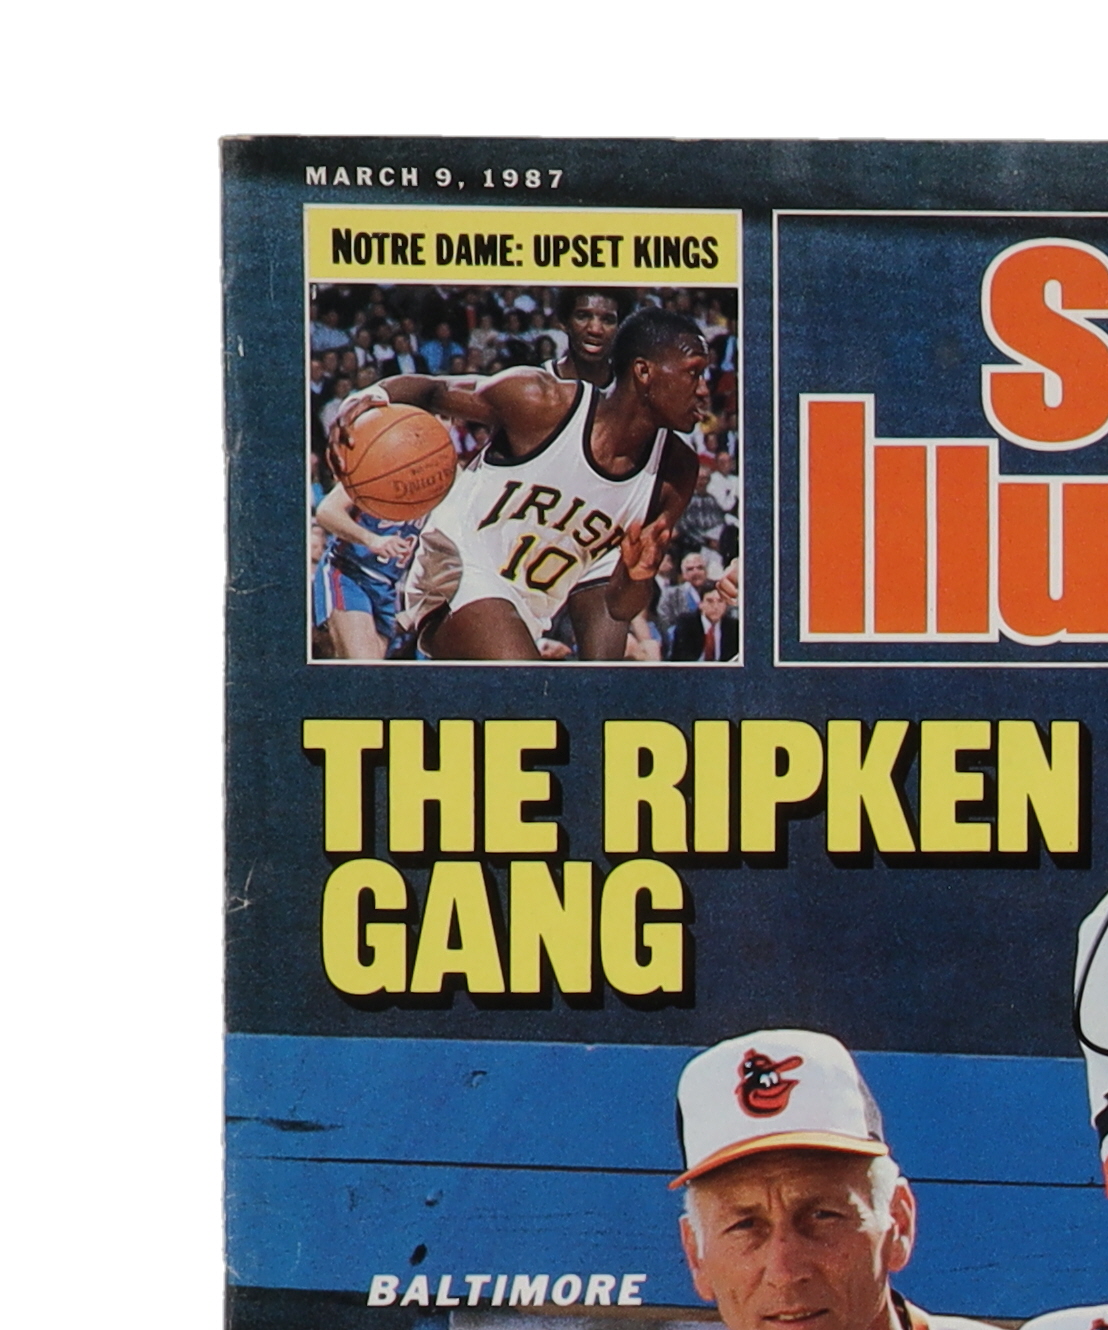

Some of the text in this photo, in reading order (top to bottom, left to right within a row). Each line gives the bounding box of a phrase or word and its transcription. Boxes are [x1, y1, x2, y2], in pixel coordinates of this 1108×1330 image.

[305, 165, 564, 190] MARCH 9, 1987
[331, 227, 719, 269] NOTRE DAME: UPSET KINGS
[500, 534, 578, 591] 10
[303, 719, 1080, 853] THE RIPKEN
[322, 858, 685, 996] GANG
[367, 1273, 648, 1307] BALTIMORE
